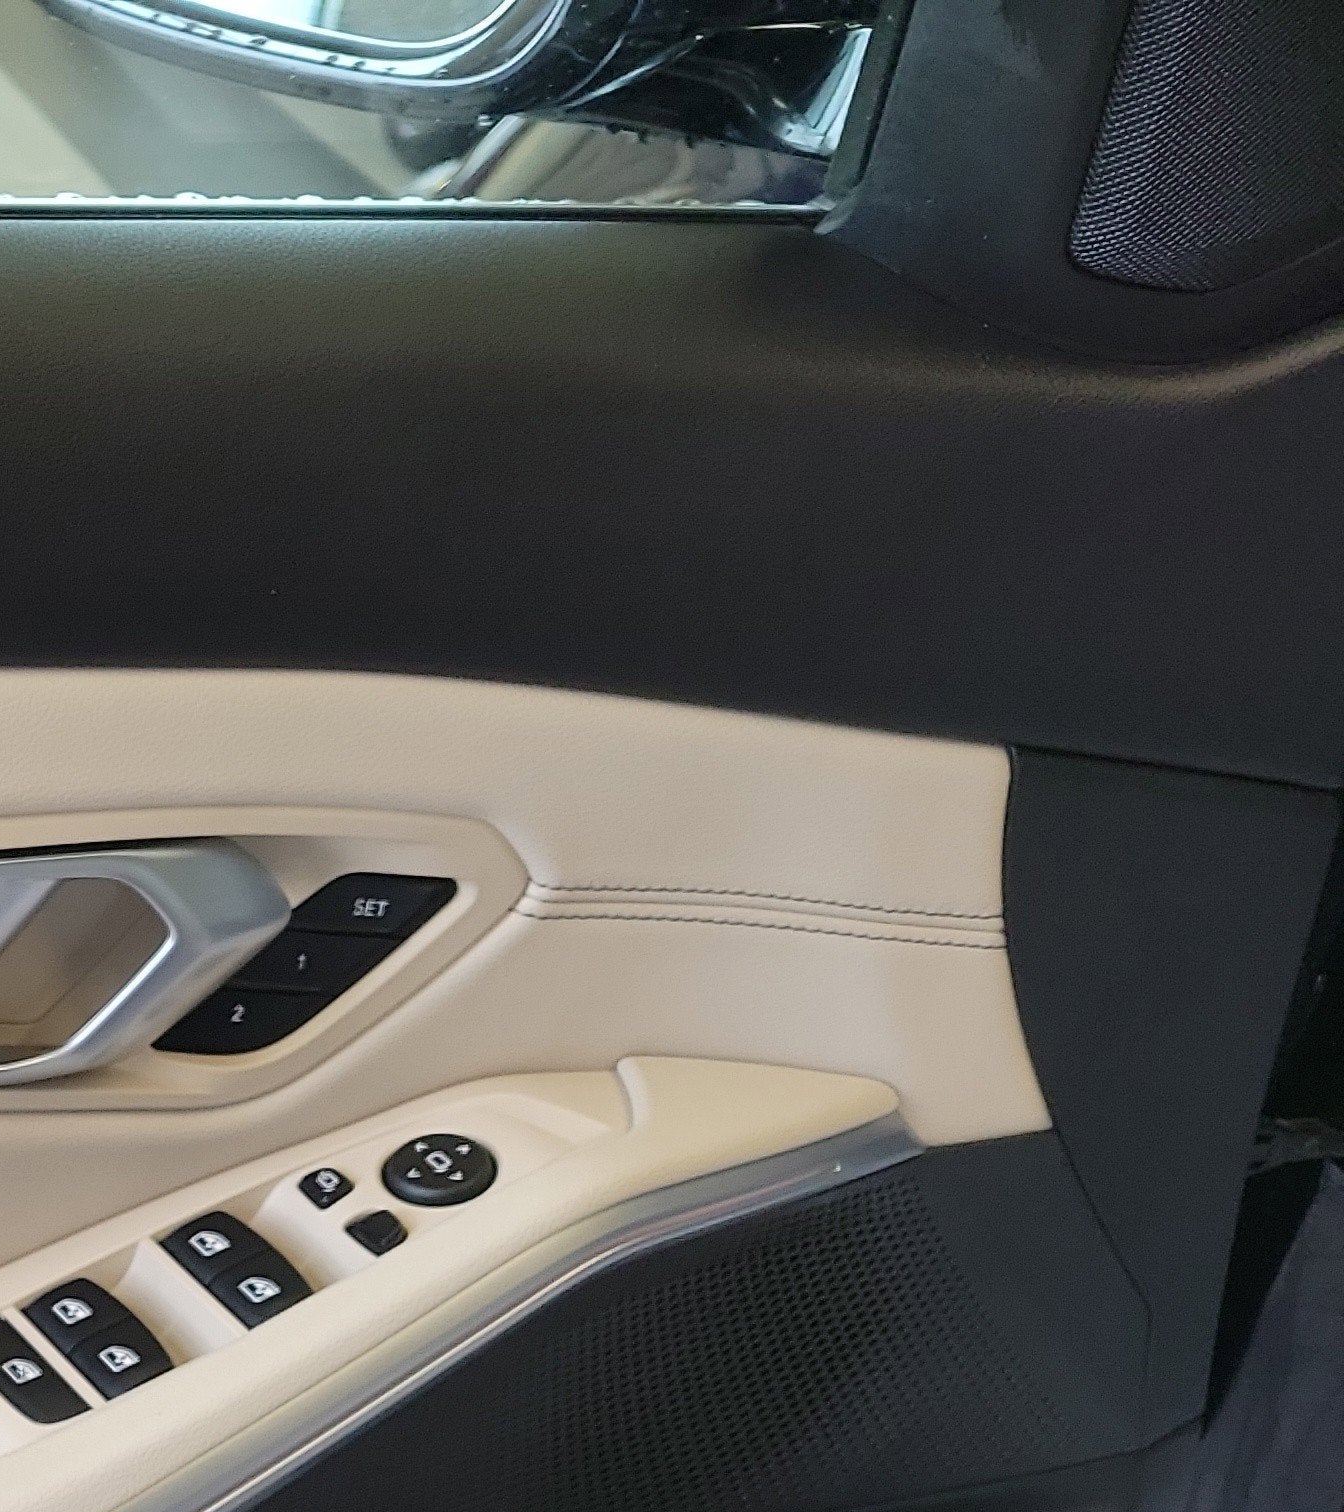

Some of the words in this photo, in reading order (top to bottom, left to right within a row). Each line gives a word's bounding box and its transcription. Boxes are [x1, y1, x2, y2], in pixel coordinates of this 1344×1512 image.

[352, 897, 390, 918] SET
[296, 952, 307, 971] 1
[230, 1003, 246, 1023] 2
